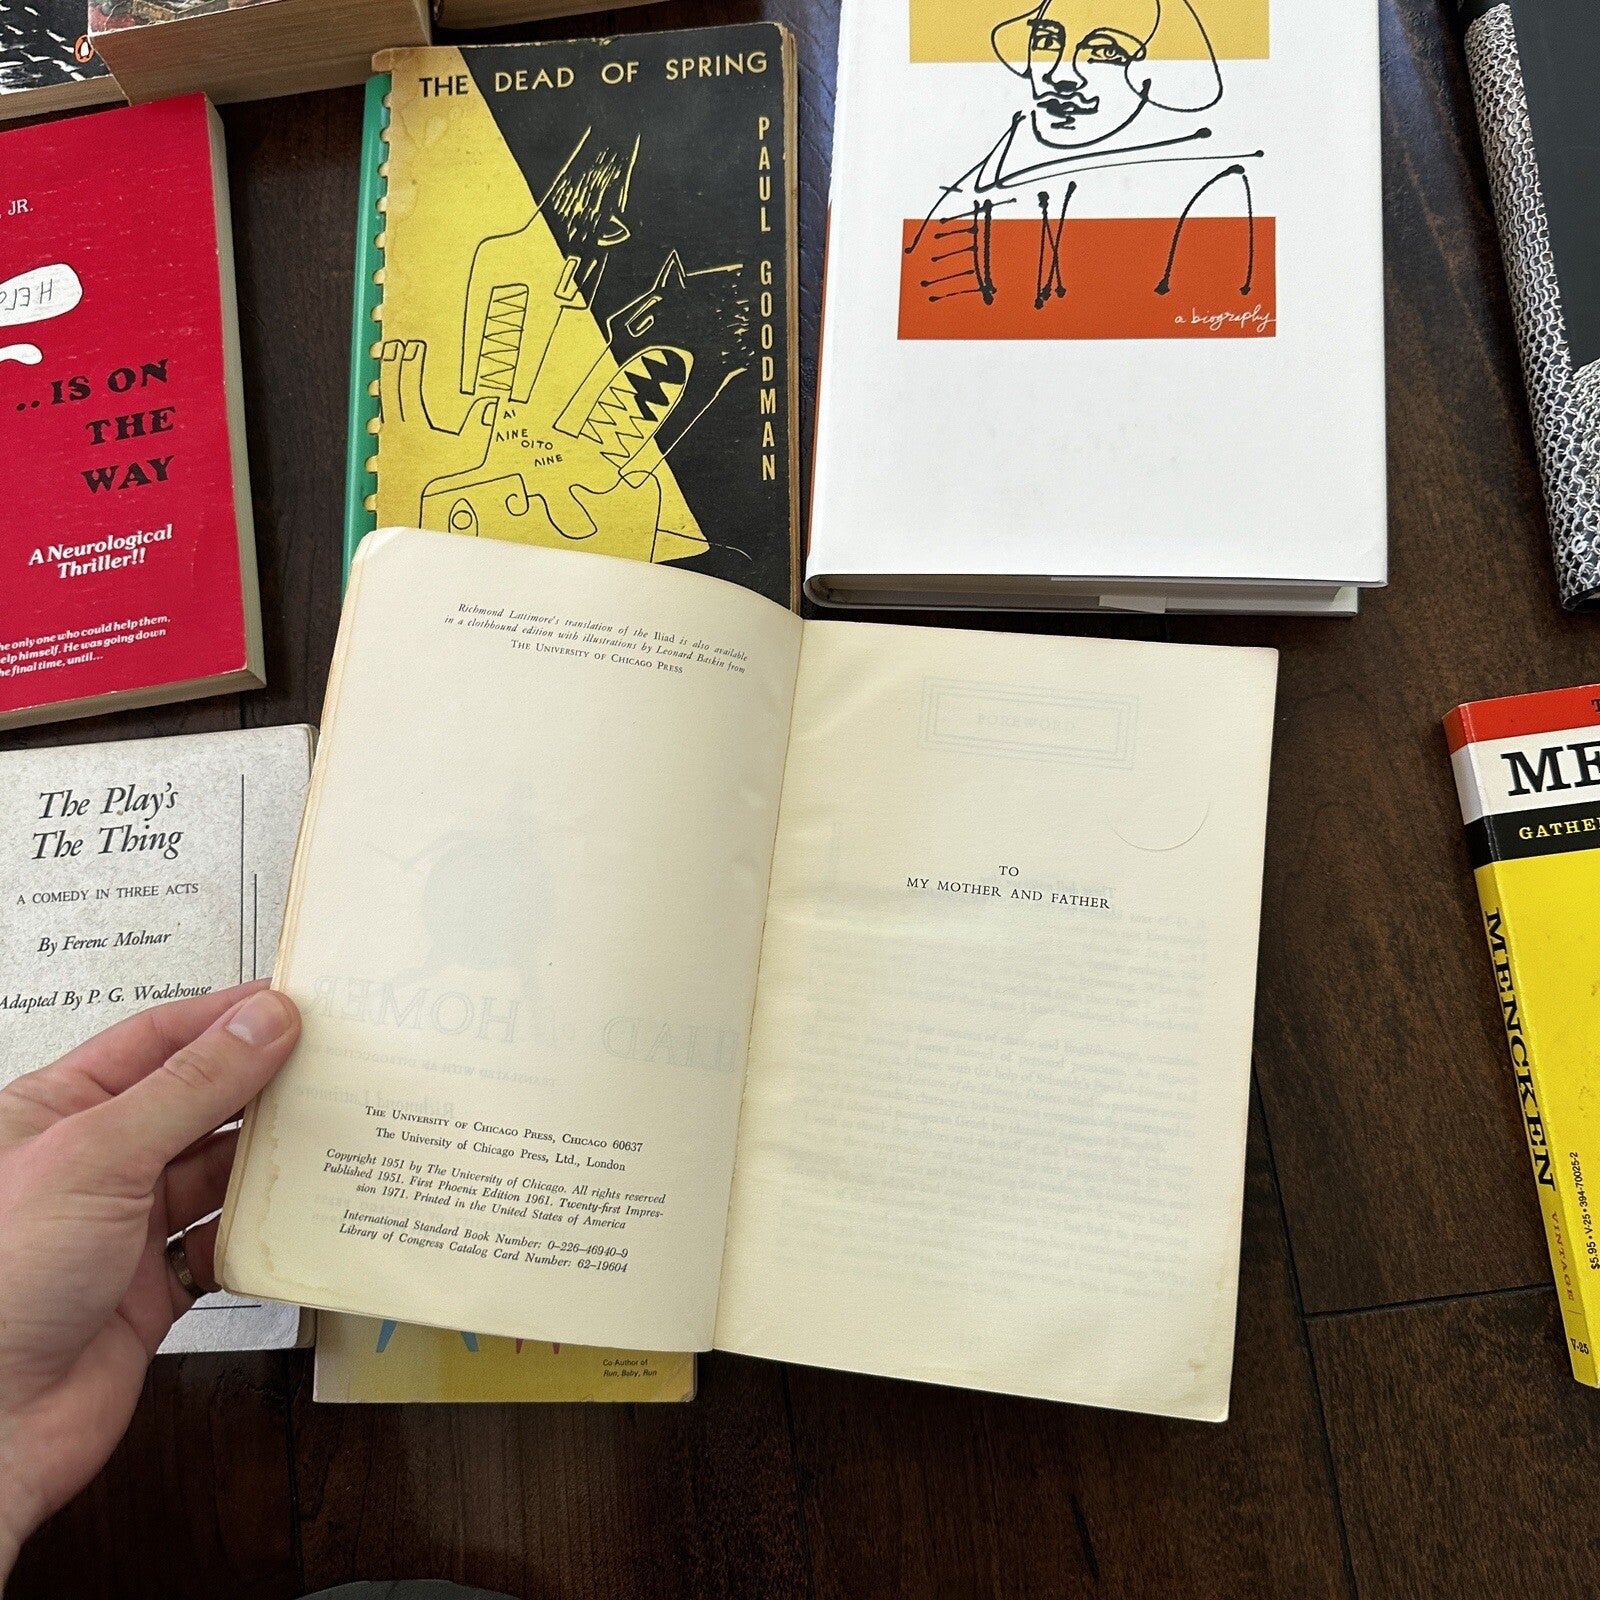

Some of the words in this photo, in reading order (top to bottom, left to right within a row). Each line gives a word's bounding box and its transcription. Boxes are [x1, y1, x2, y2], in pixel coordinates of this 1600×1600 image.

[419, 75, 469, 98] THE
[494, 67, 575, 93] DEAD
[601, 61, 640, 85] OF
[665, 51, 768, 81] SPRING
[758, 116, 771, 232] PAUL
[7, 198, 34, 216] JR.
[1174, 315, 1186, 324] a
[1191, 304, 1276, 333] biography
[107, 358, 169, 393] ON
[760, 260, 776, 481] GOODMAN
[85, 406, 175, 446] THE
[81, 455, 175, 494] WAY
[28, 549, 44, 566] A
[47, 523, 173, 562] Neurological
[57, 547, 147, 579] Thriller!!
[11, 637, 35, 649] only
[36, 634, 56, 645] one
[57, 630, 80, 641] who
[80, 623, 113, 637] could
[113, 620, 138, 633] help
[138, 615, 171, 627] them.
[18, 645, 62, 661] himself.
[63, 643, 80, 653] He
[80, 639, 103, 649] was
[104, 633, 135, 648] going
[135, 628, 166, 641] down
[444, 615, 454, 624] in
[467, 617, 519, 632] clothbound
[522, 626, 554, 638] edition
[558, 630, 579, 641] with
[582, 633, 638, 651] illustrations
[641, 642, 653, 654] by
[655, 645, 694, 661] Leonard
[696, 653, 725, 668] Baskin
[726, 661, 746, 674] from
[458, 603, 505, 618] Richmond
[508, 610, 560, 625] Lattimore's
[564, 619, 613, 633] translation
[618, 624, 630, 636] of
[633, 627, 649, 639] the
[653, 631, 675, 643] Iliad
[679, 636, 688, 646] is
[692, 640, 710, 651] also
[714, 645, 749, 662] available
[11, 661, 37, 678] final
[38, 658, 66, 670] time,
[38, 789, 91, 820] The
[100, 782, 179, 822] Play's
[32, 829, 84, 860] The
[98, 823, 184, 860] Thing
[1518, 816, 1600, 840] GATHE
[999, 865, 1020, 877] TO
[16, 894, 26, 905] A
[32, 889, 90, 904] COMEDY
[96, 889, 110, 899] IN
[117, 885, 159, 898] THREE
[165, 883, 199, 895] ACTS
[907, 877, 930, 889] MY
[937, 881, 1002, 898] MOTHER
[1010, 889, 1043, 901] AND
[1051, 893, 1110, 909] FATHER
[37, 936, 58, 957] By
[62, 934, 108, 951] Ferenc
[113, 929, 172, 948] Molnar
[0, 990, 59, 1013] Adapted
[62, 990, 83, 1011] By
[87, 989, 101, 1005] P.
[108, 987, 125, 1003] G.
[134, 982, 212, 1001] Wodehouse
[1484, 906, 1556, 1191] MENCKEN
[376, 1127, 395, 1139] The
[401, 1131, 452, 1149] University
[457, 1140, 469, 1150] of
[473, 1141, 515, 1158] Chicago
[520, 1148, 549, 1163] Press,
[555, 1153, 580, 1167] Ltd.,
[586, 1156, 626, 1171] London
[612, 1140, 643, 1153] 60637
[323, 1162, 374, 1179] Published
[377, 1170, 404, 1184] 1951.
[409, 1175, 433, 1188] First
[438, 1180, 479, 1196] Phoenix
[482, 1187, 520, 1202] Edition
[525, 1193, 554, 1206] 1961.
[559, 1197, 621, 1214] Twenty-first
[625, 1205, 664, 1219] Impres-
[326, 1148, 377, 1166] Copyright
[380, 1156, 405, 1169] 1951
[409, 1160, 422, 1174] by
[427, 1164, 447, 1176] The
[451, 1167, 502, 1186] University
[506, 1176, 519, 1188] of
[522, 1178, 567, 1194] Chicago.
[572, 1185, 588, 1196] All
[591, 1187, 621, 1201] rights
[625, 1192, 667, 1204] reserved
[1569, 1151, 1589, 1208] 394-70025-2
[356, 1183, 377, 1194] sion
[382, 1186, 409, 1199] 1971.
[413, 1191, 451, 1206] Printed
[454, 1198, 466, 1208] in
[469, 1200, 487, 1212] the
[491, 1203, 528, 1218] United
[532, 1209, 563, 1223] States
[567, 1214, 580, 1225] of
[583, 1217, 627, 1229] America
[1582, 1213, 1594, 1234] V-25
[339, 1223, 378, 1239] Library
[382, 1231, 395, 1242] of
[398, 1232, 445, 1249] Congress
[449, 1241, 488, 1258] Catalog
[493, 1248, 520, 1261] Card
[524, 1252, 572, 1267] Number:
[343, 1209, 410, 1228] International
[413, 1220, 459, 1237] Standard
[464, 1229, 491, 1242] Book
[495, 1233, 542, 1249] Number:
[1551, 1210, 1575, 1302] VINTAGE
[1586, 1241, 1600, 1270] $5.95
[643, 1368, 657, 1376] Run
